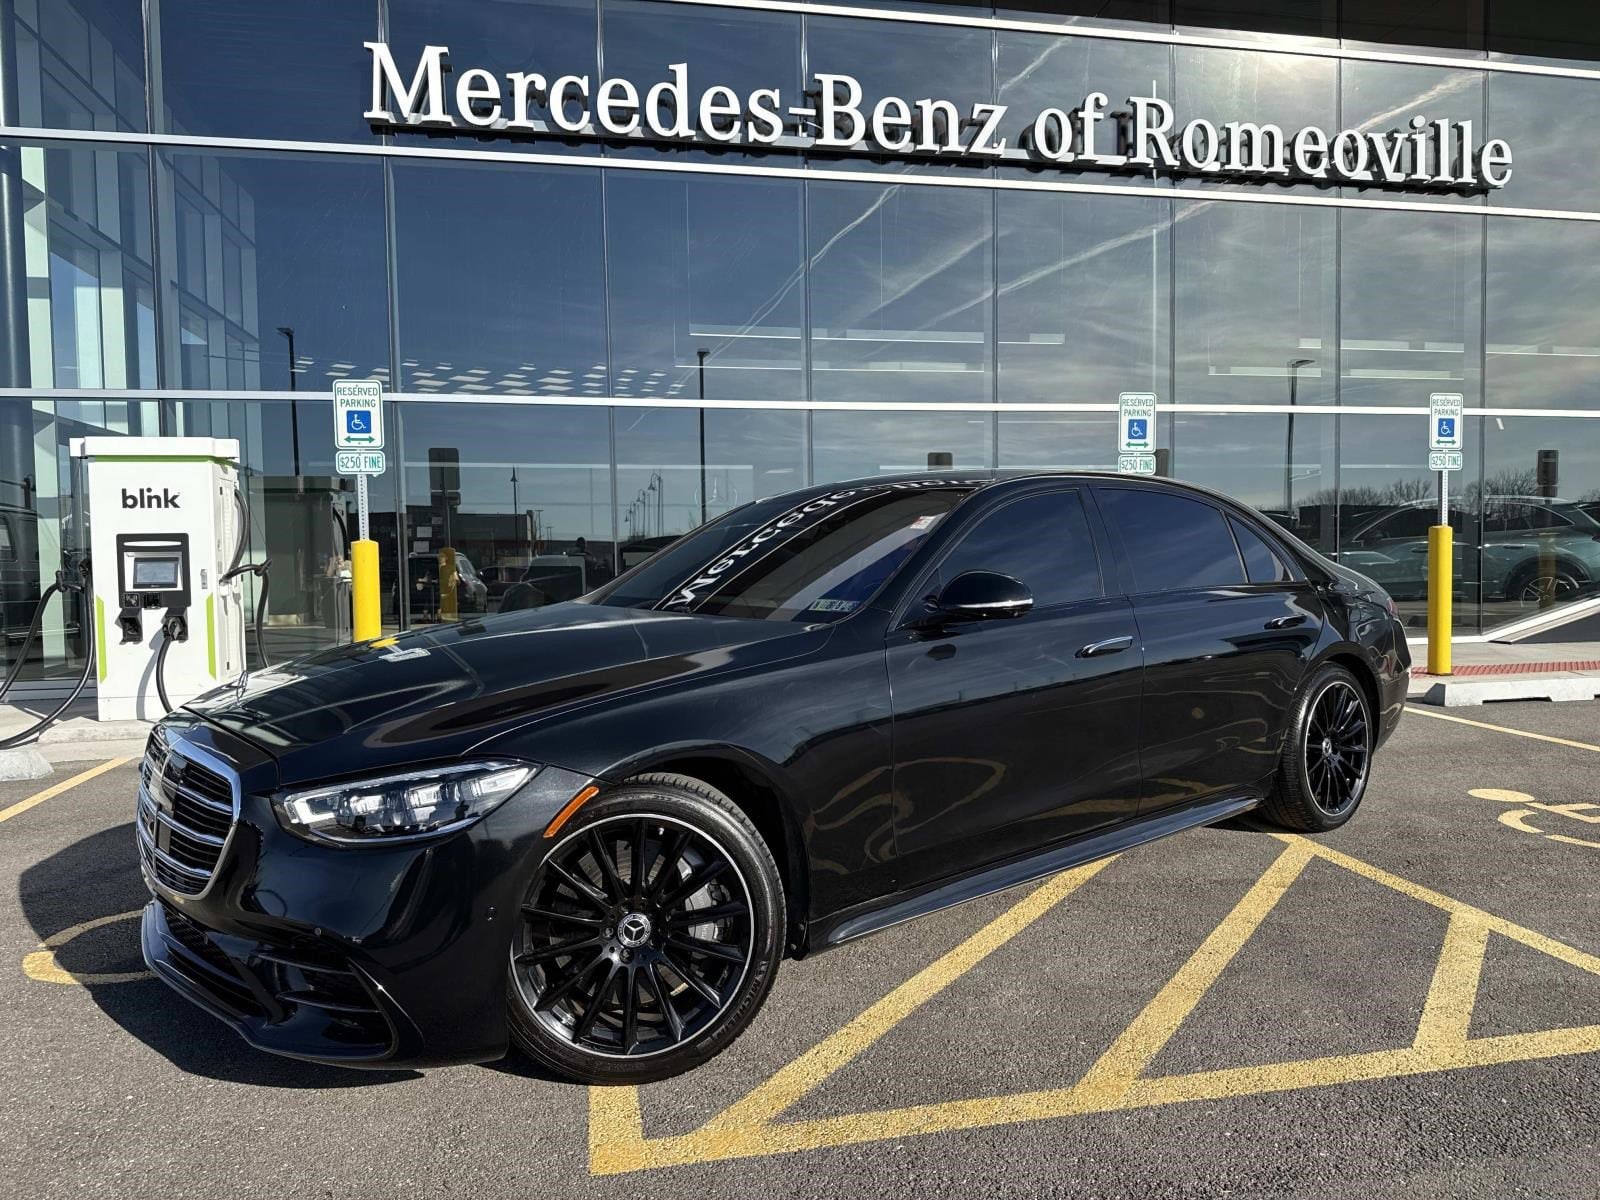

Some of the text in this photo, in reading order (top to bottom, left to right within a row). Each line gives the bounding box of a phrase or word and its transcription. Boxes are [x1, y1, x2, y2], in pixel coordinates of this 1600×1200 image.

[363, 41, 1513, 187] Mercedes-Benz of Romeoville
[337, 387, 378, 396] RESERVED
[340, 398, 376, 408] PARKING
[1122, 399, 1153, 407] RESERVED
[1432, 399, 1460, 407] RESERVED
[1124, 409, 1152, 417] PARKING
[339, 456, 382, 469] $250 FINE
[1121, 459, 1152, 470] $250 FINE
[1432, 456, 1460, 466] $250 FINE
[121, 487, 181, 509] blink
